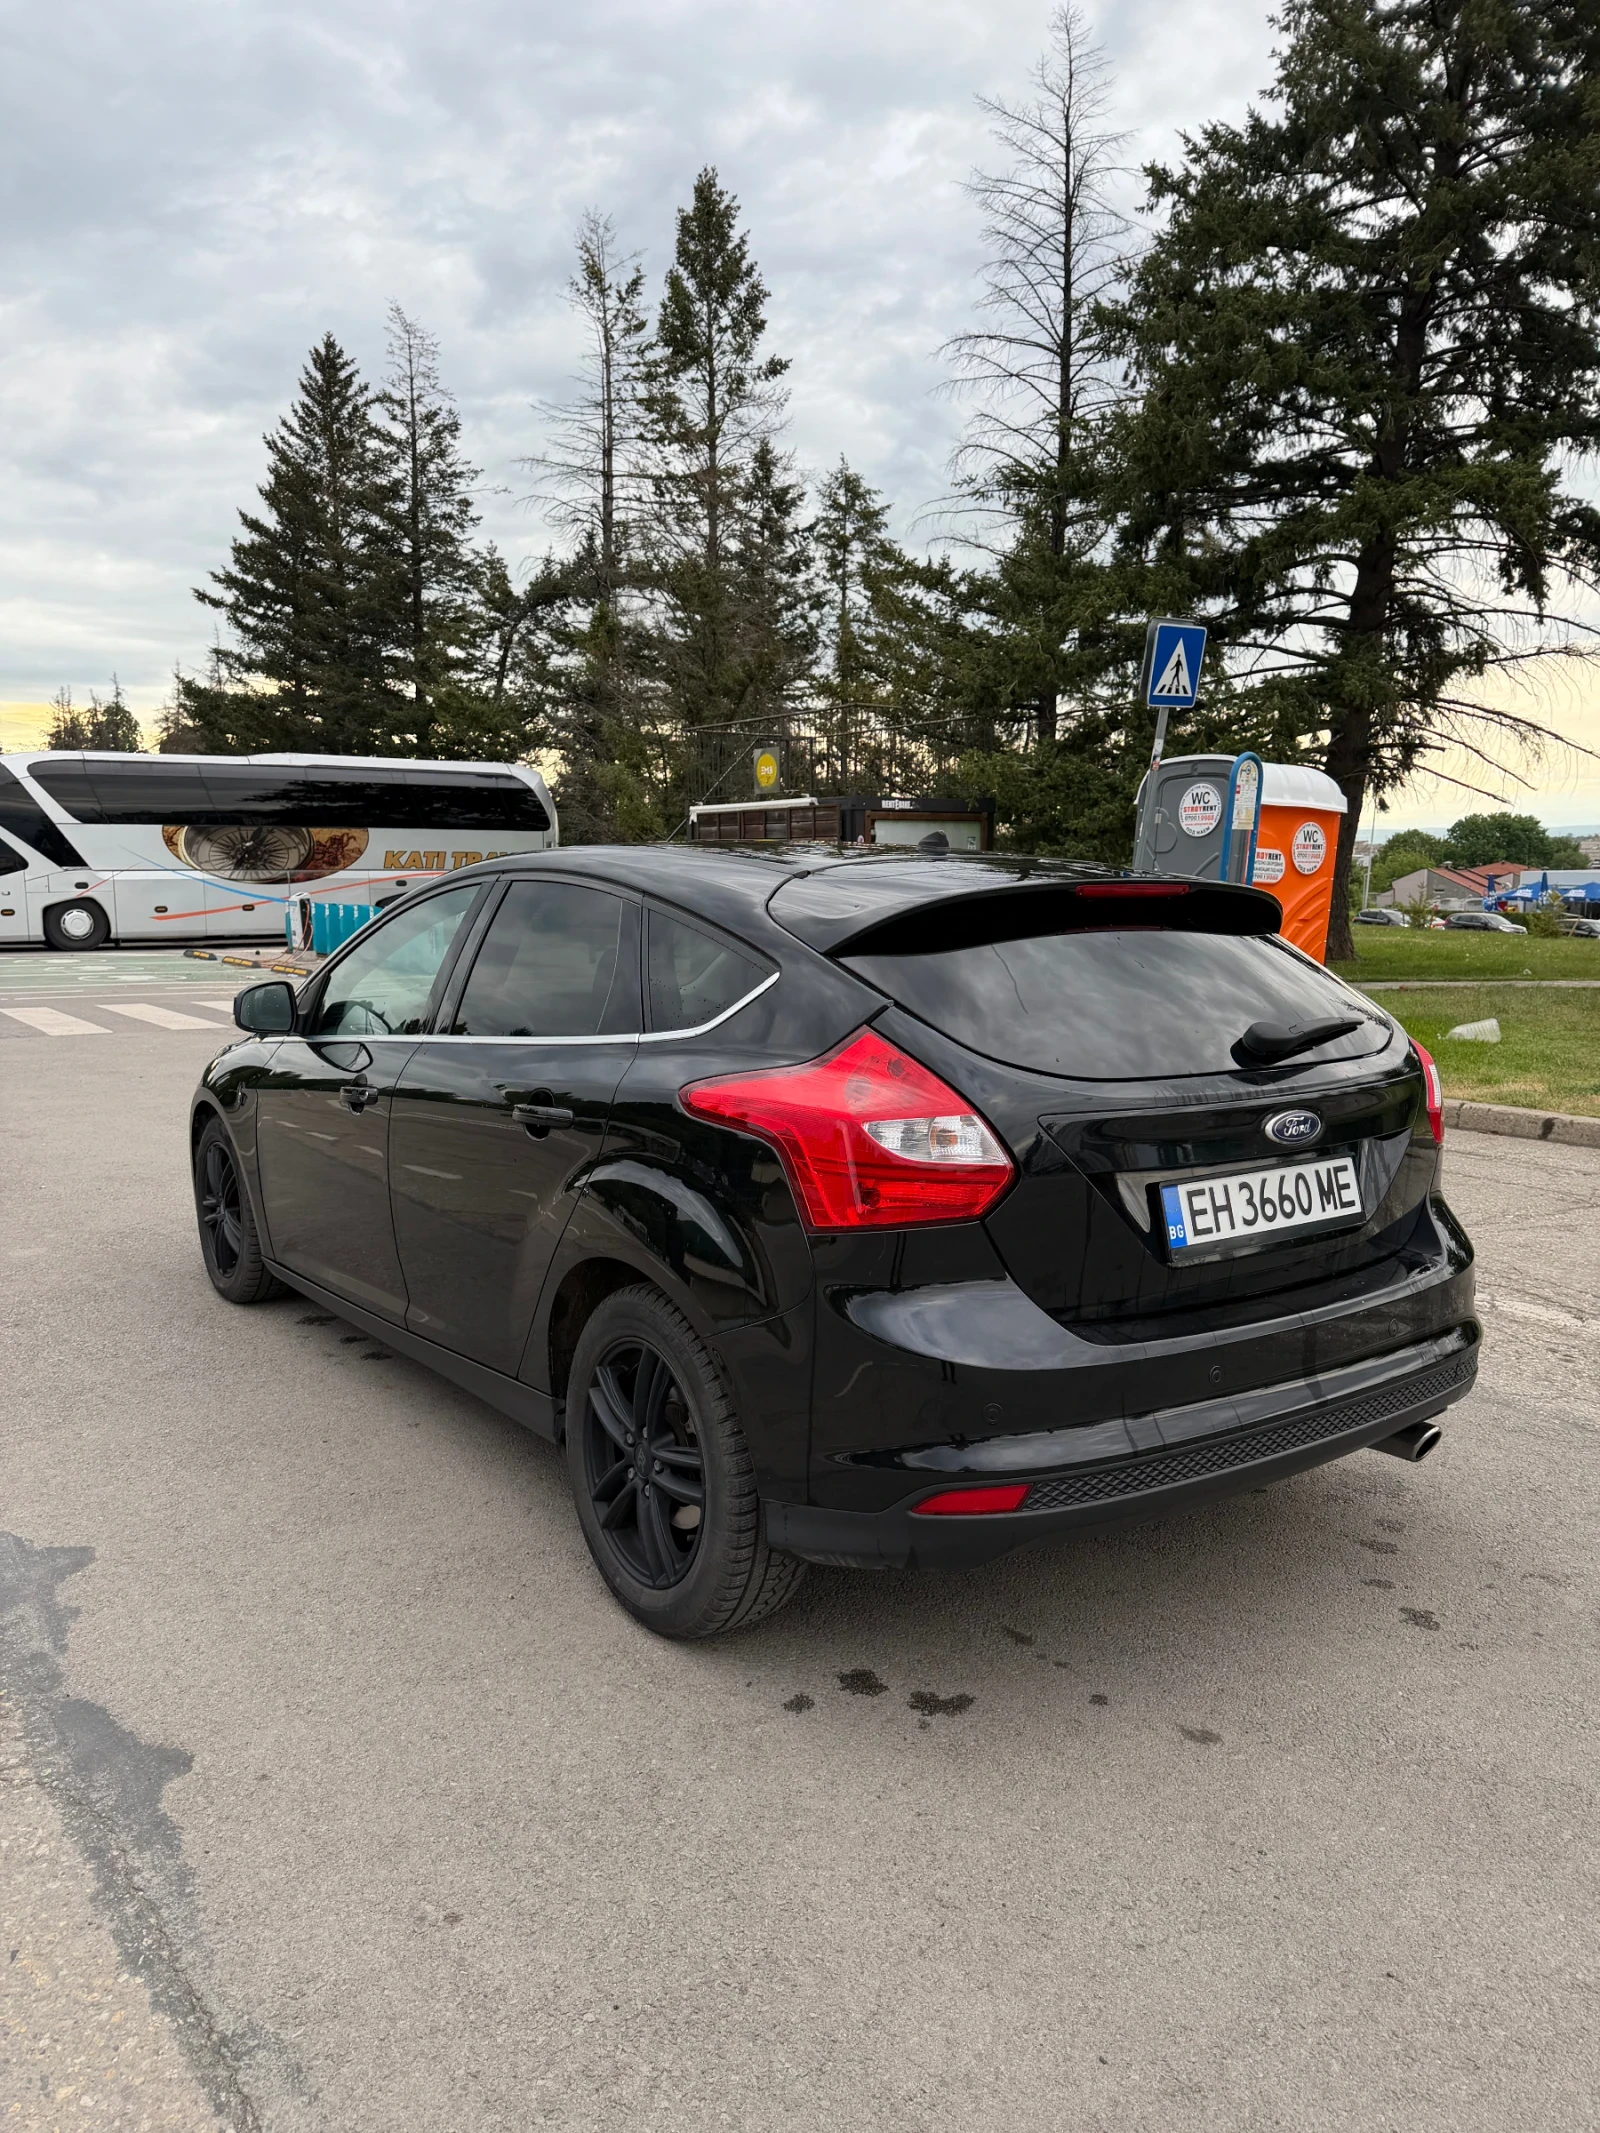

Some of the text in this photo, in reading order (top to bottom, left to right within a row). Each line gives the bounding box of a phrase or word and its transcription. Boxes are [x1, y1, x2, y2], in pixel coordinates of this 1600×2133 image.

[1191, 791, 1210, 805] WC
[1303, 830, 1319, 843] WC
[383, 850, 508, 869] KATI TR
[1284, 1116, 1312, 1137] Ford
[1168, 1225, 1185, 1240] BG
